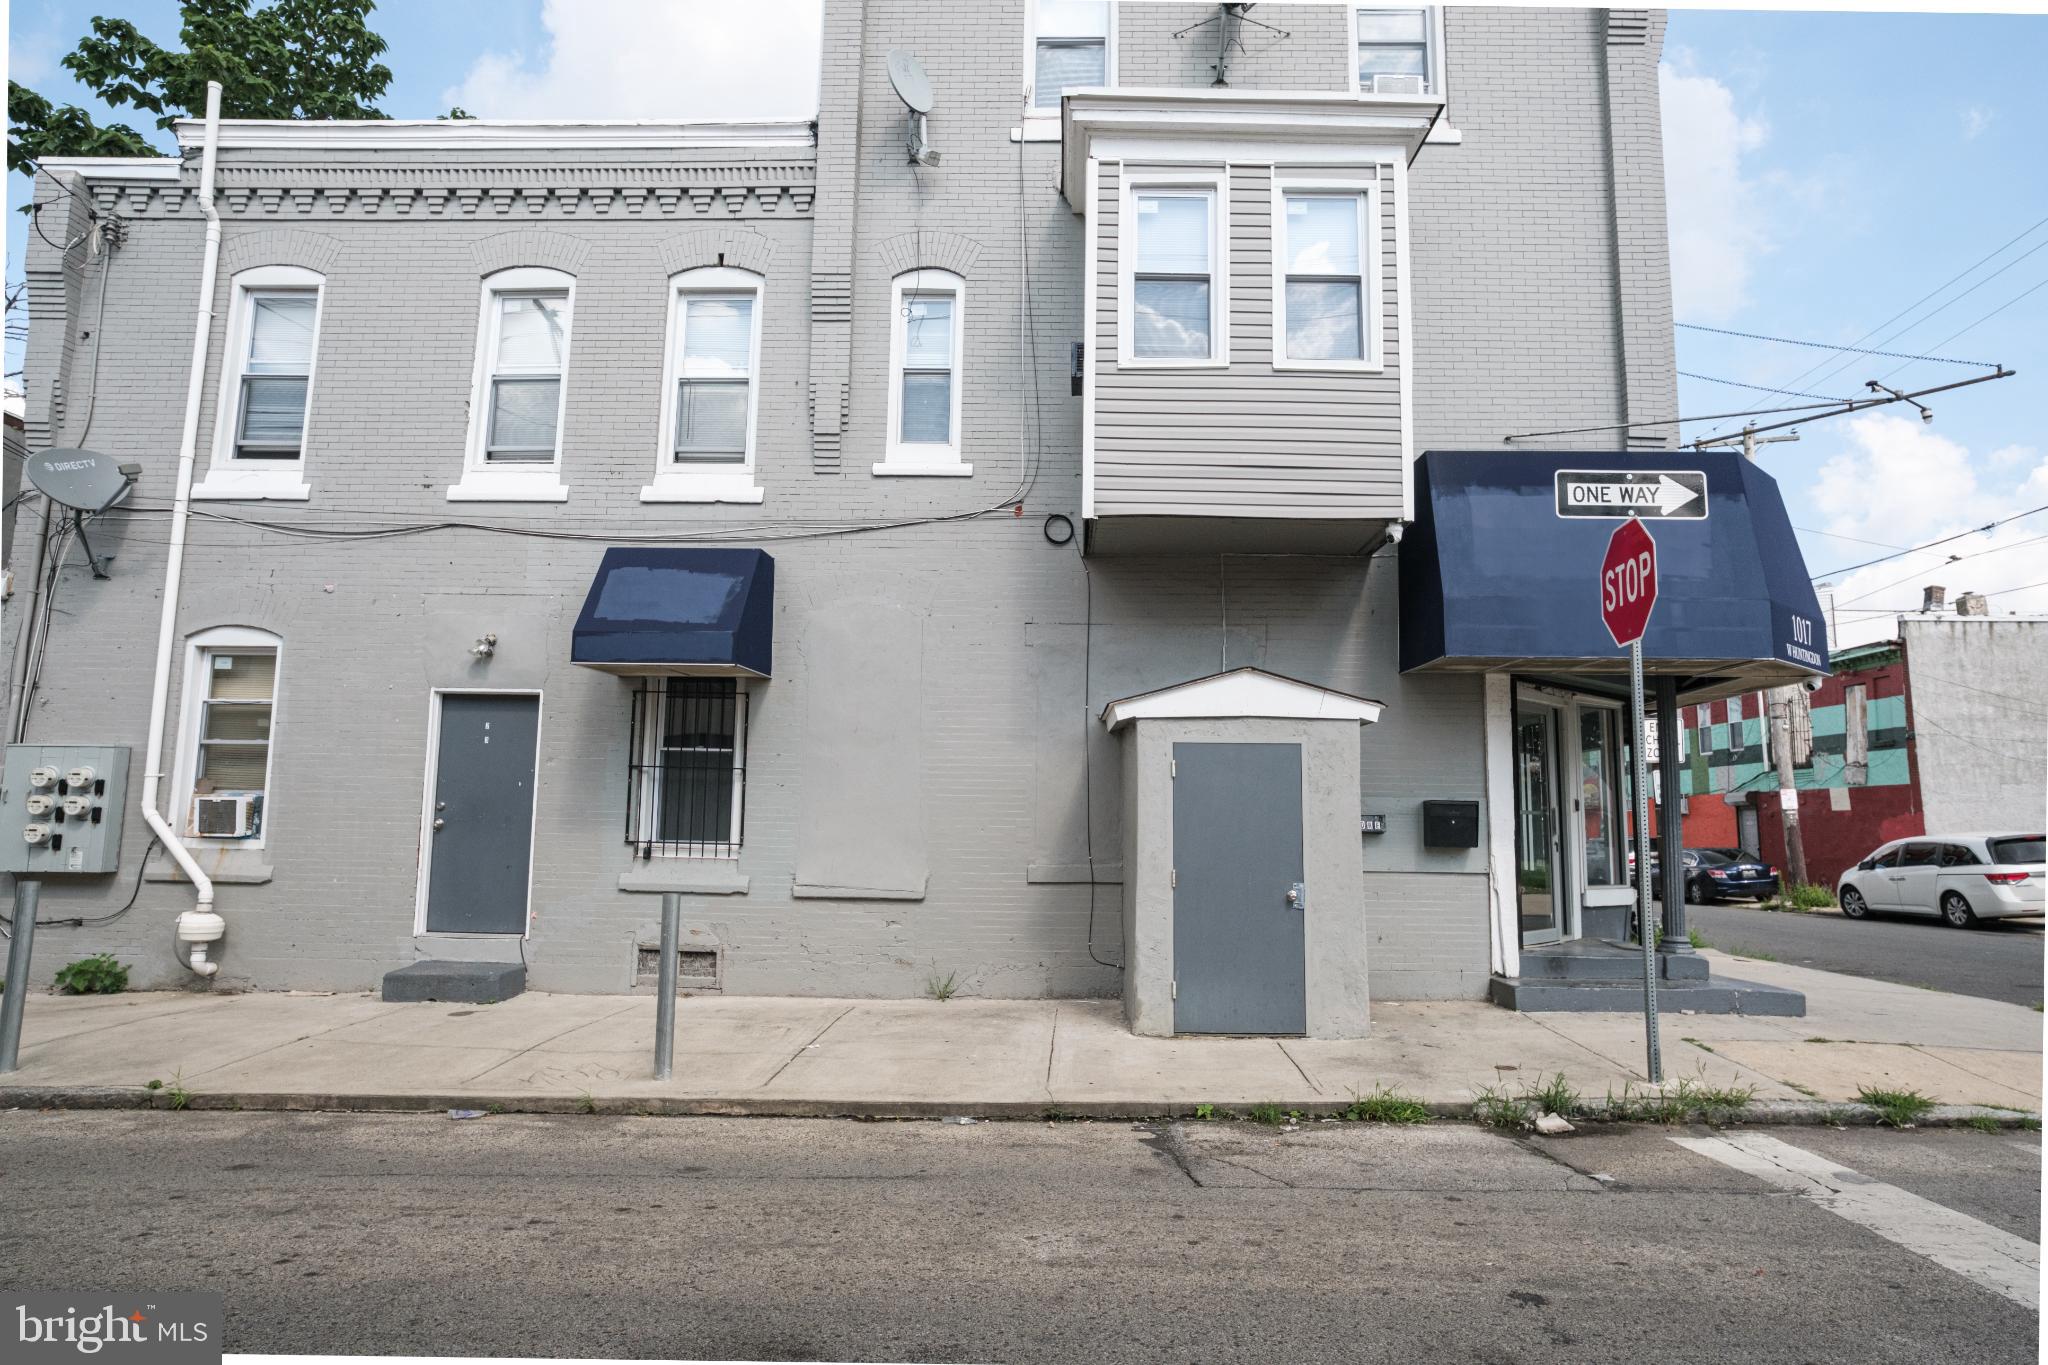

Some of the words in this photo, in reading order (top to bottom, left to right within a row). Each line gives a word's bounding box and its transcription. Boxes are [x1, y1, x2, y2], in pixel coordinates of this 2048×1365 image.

[54, 458, 96, 471] DIRECTV
[1572, 485, 1611, 504] ONE
[1619, 486, 1660, 504] WAY
[1605, 551, 1652, 612] STOP
[1791, 614, 1812, 646] 1017
